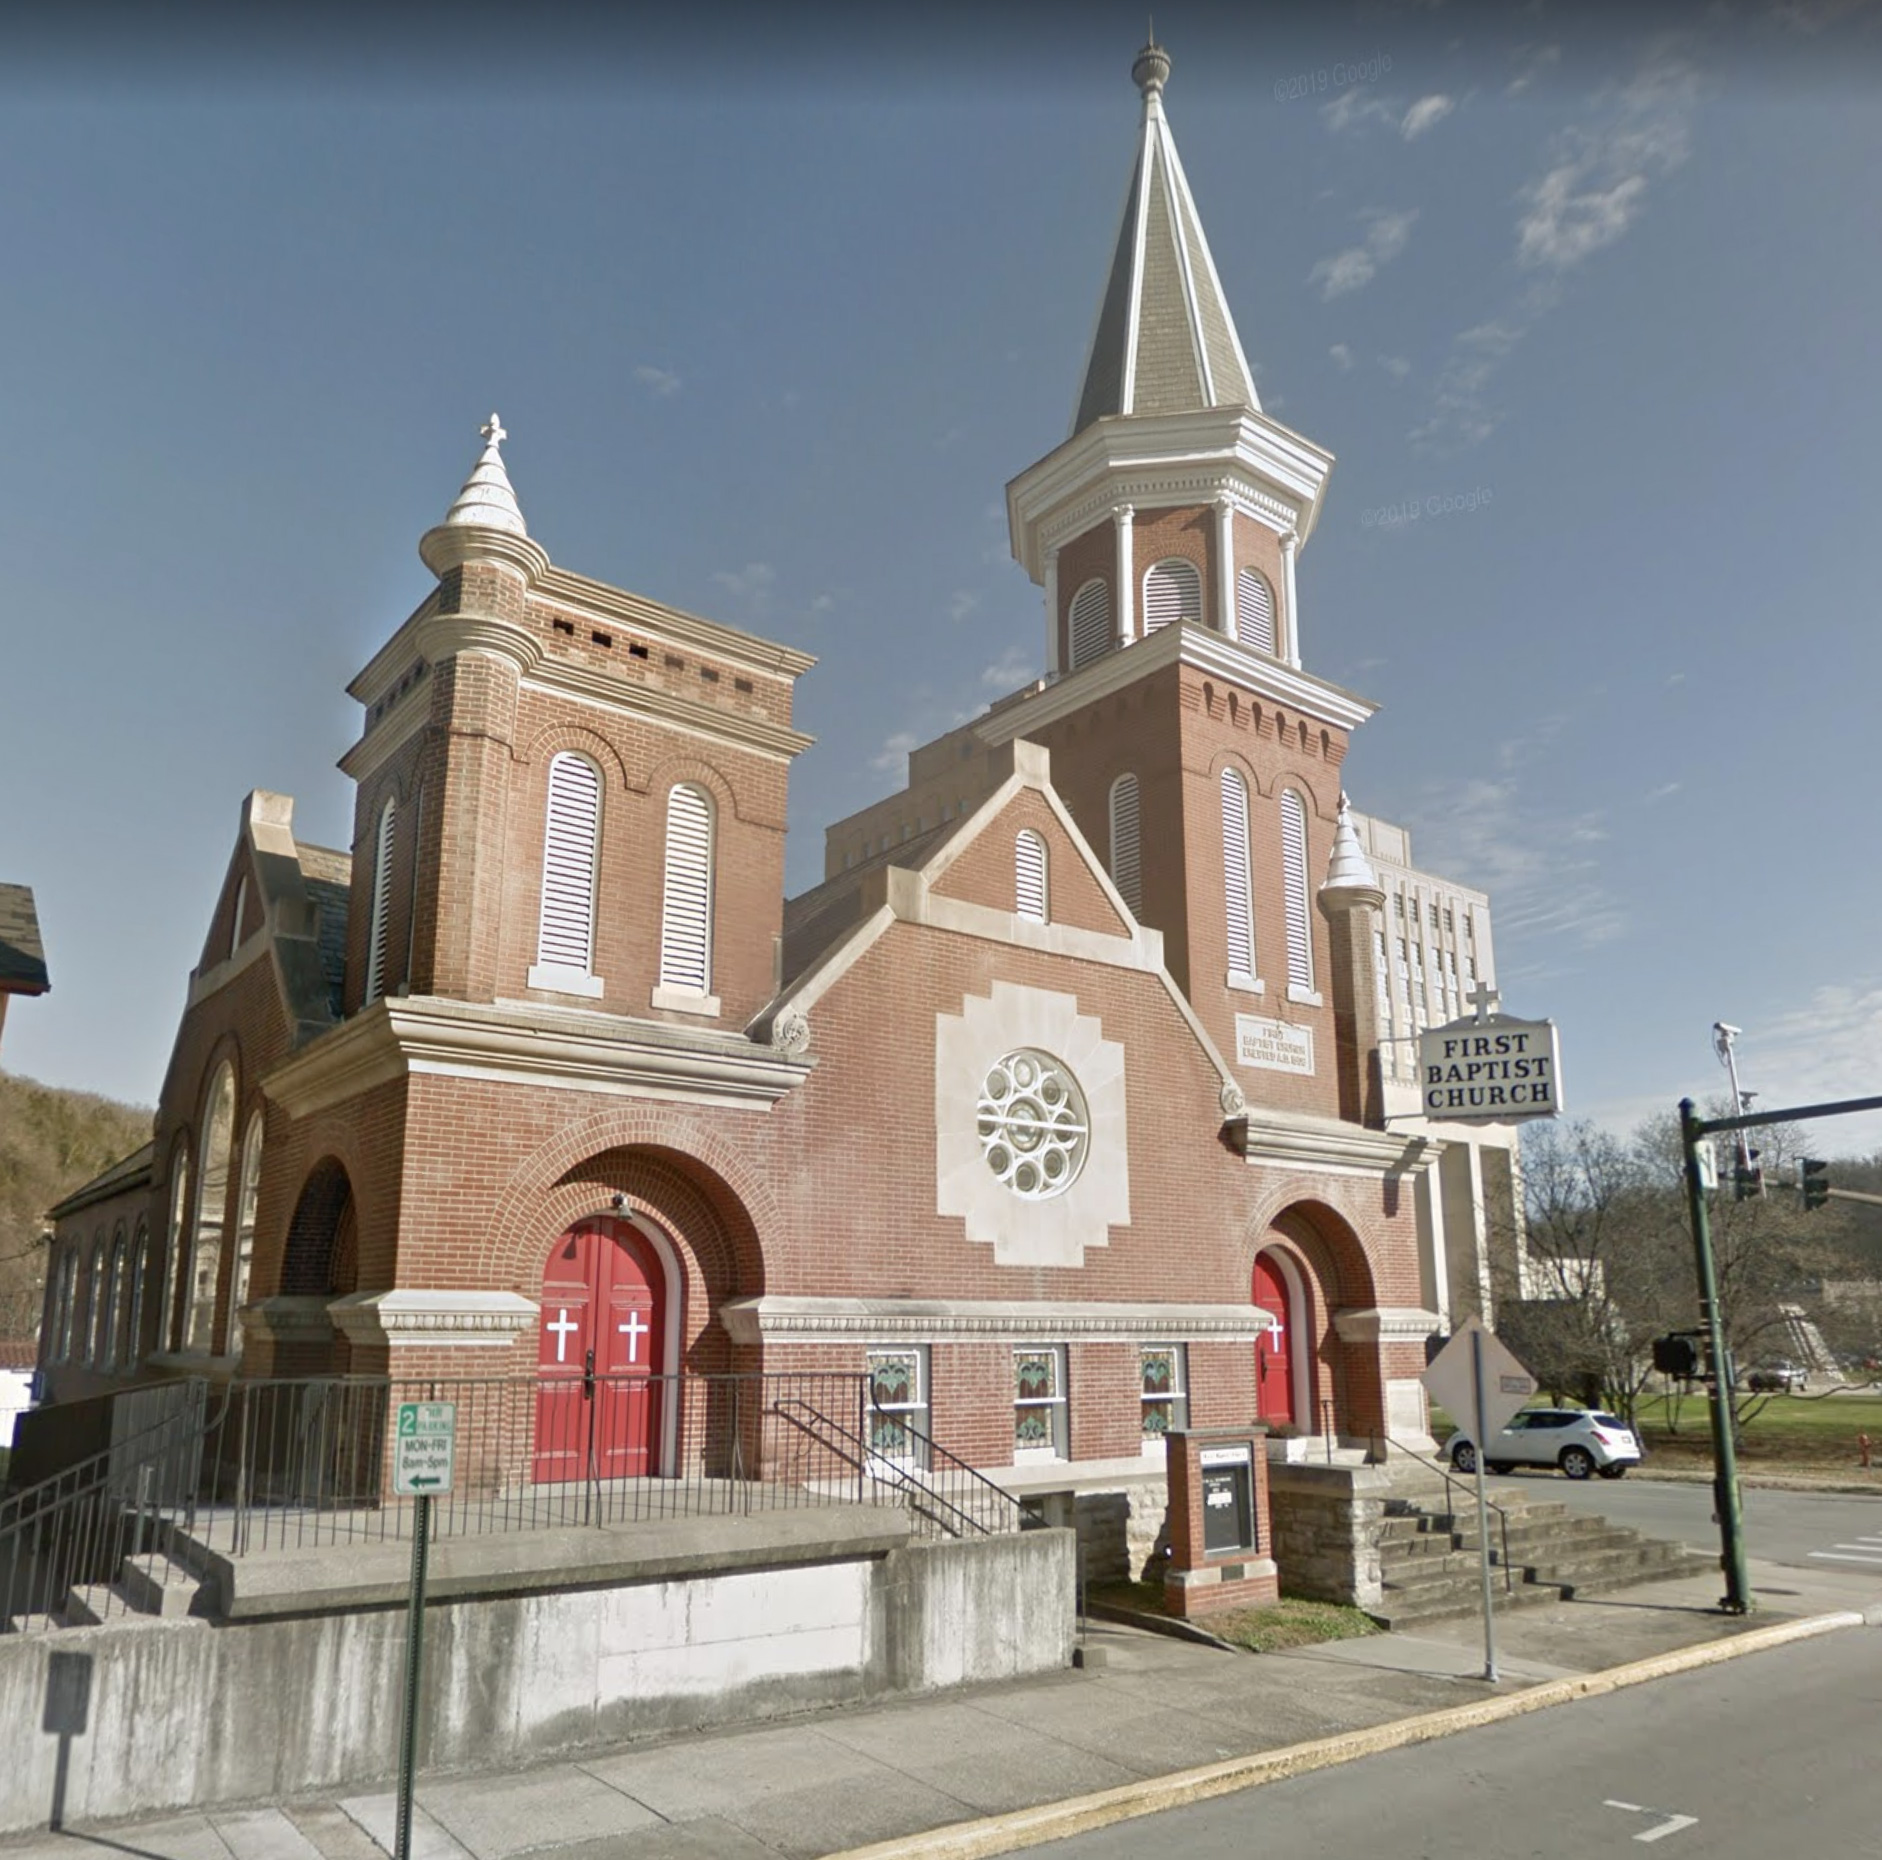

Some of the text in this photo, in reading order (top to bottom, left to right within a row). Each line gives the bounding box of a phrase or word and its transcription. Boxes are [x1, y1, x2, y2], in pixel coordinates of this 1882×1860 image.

[1443, 1034, 1529, 1059] FIRST
[1427, 1057, 1549, 1084] BAPTIST
[1427, 1082, 1550, 1109] CHURCH
[402, 1411, 414, 1433] 2
[405, 1438, 447, 1453] MON-FRI
